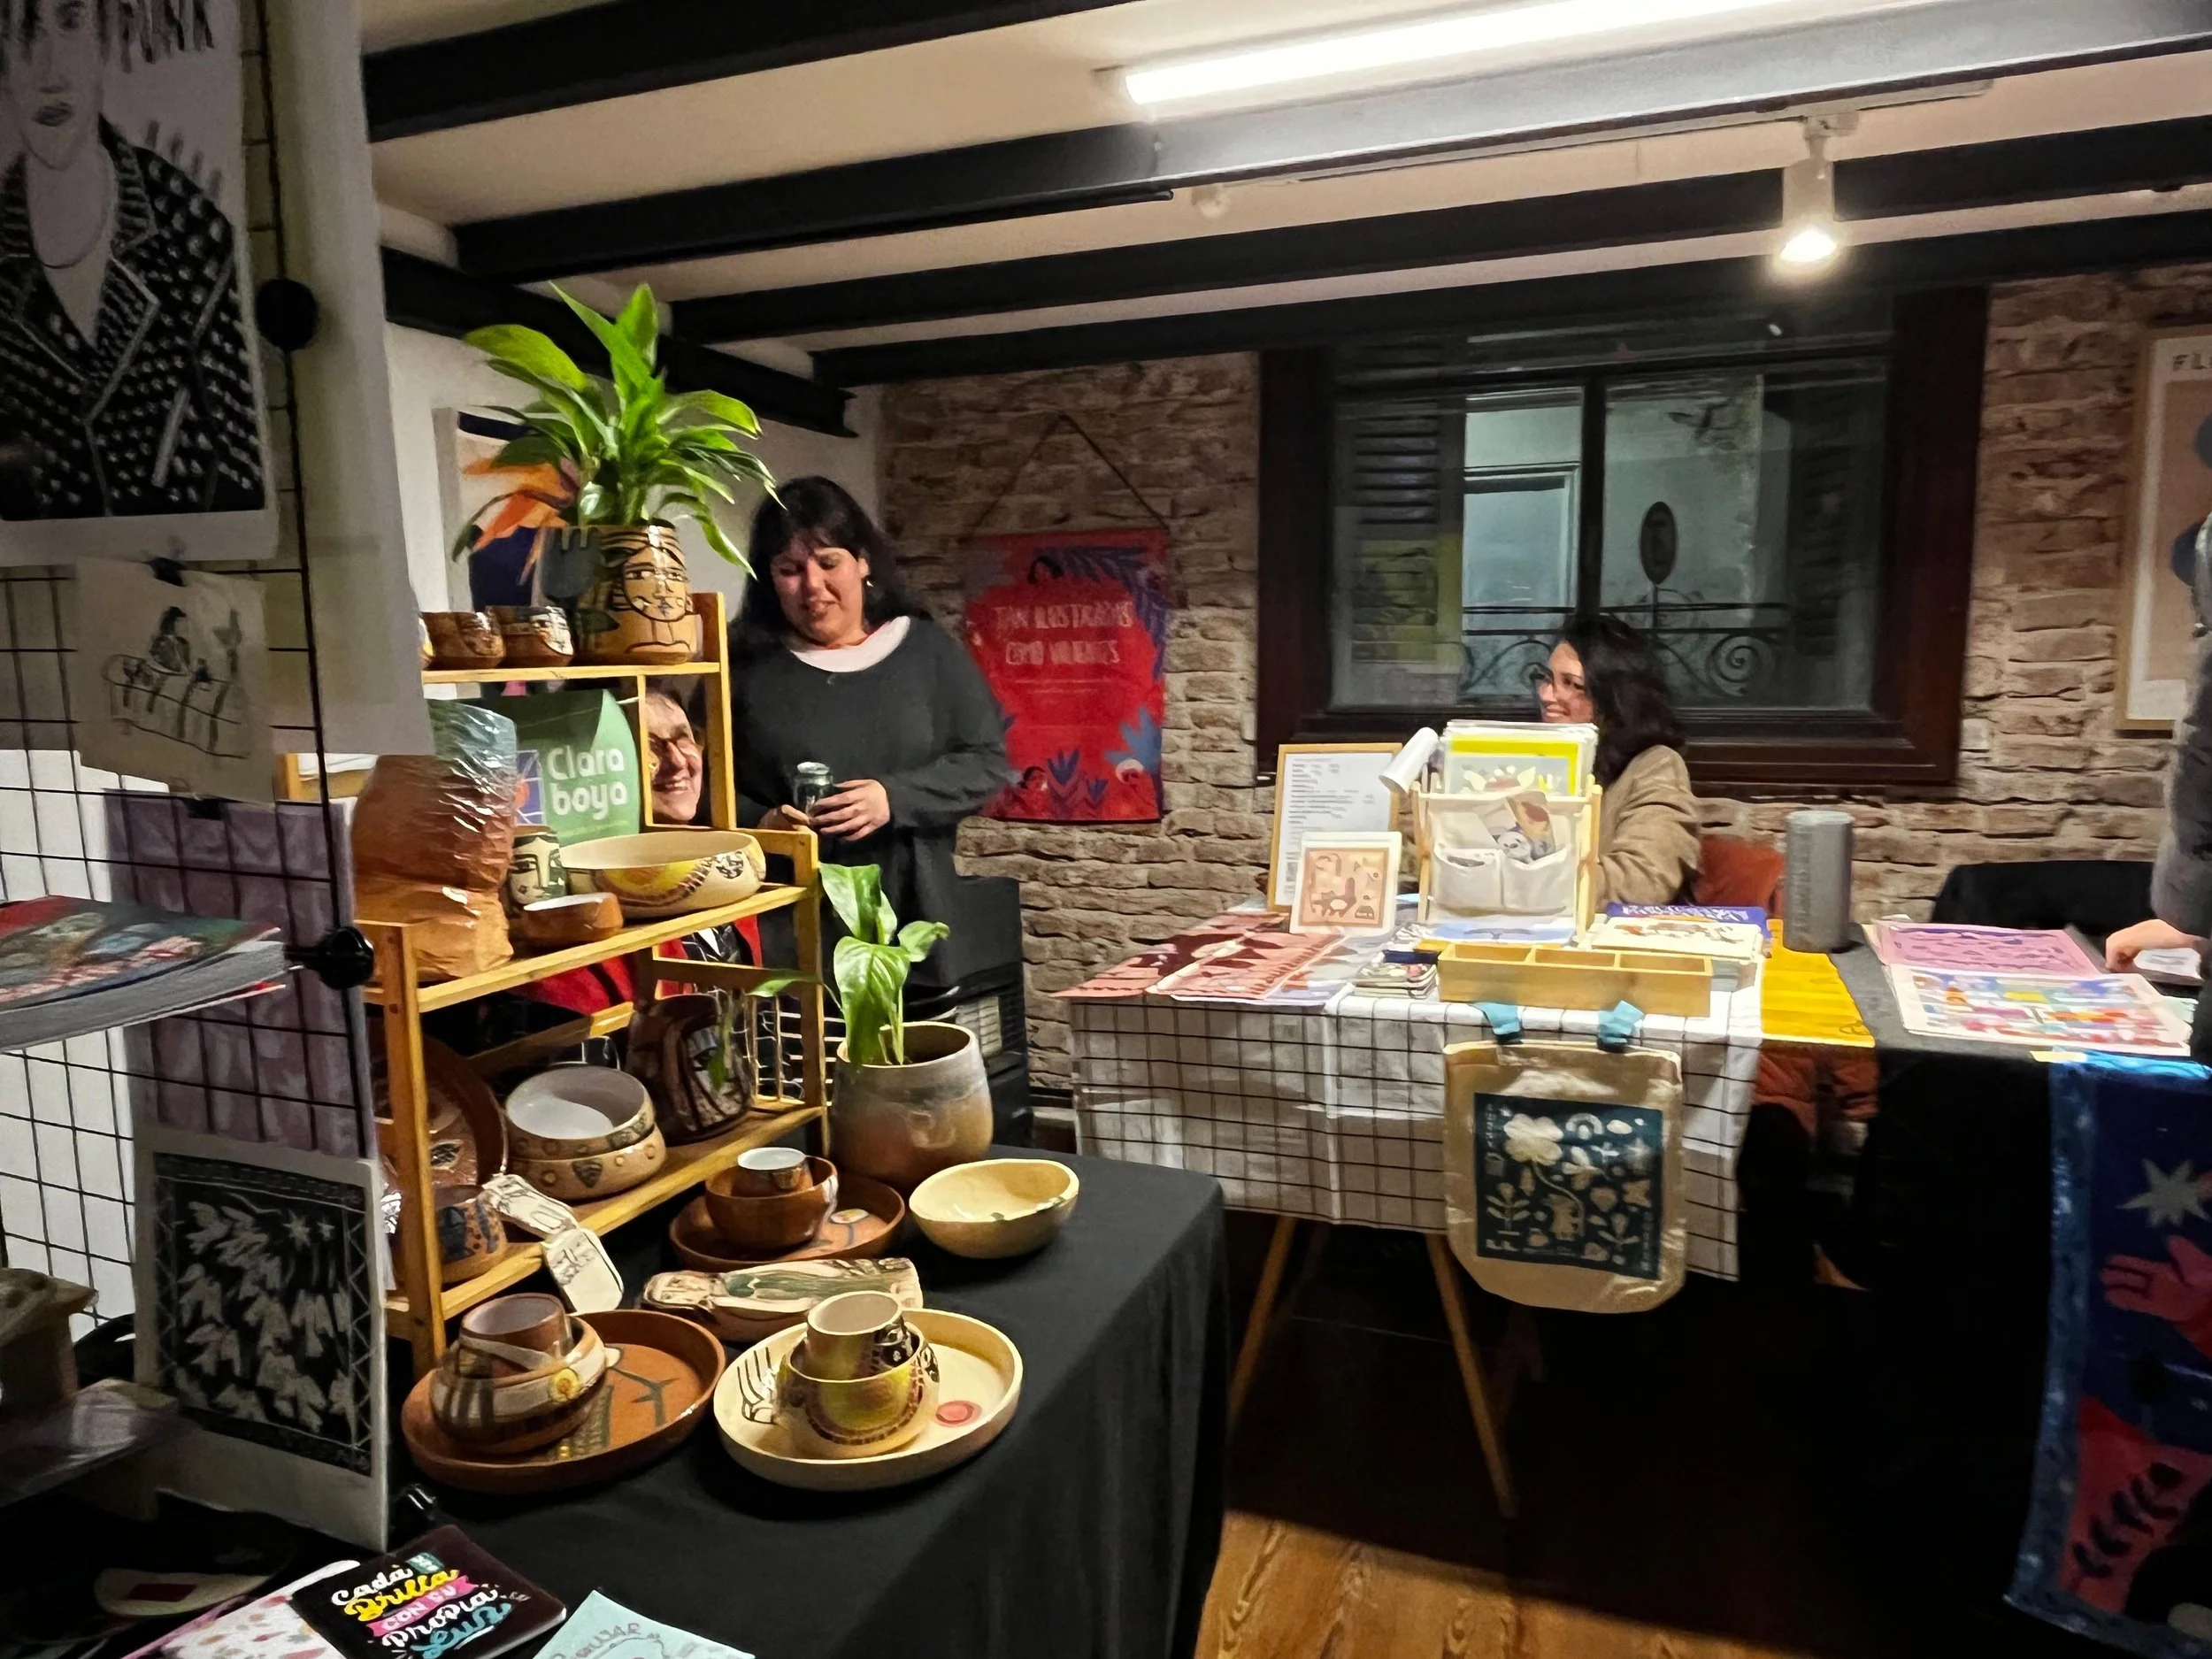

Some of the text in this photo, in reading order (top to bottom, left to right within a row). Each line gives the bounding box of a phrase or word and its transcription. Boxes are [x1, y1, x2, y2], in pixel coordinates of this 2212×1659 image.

[2172, 352, 2212, 371] FL
[547, 744, 625, 780] Clara
[549, 781, 629, 820] boya
[331, 1569, 414, 1606] Cada
[343, 1569, 459, 1622] Brilla
[380, 1601, 427, 1631] CON
